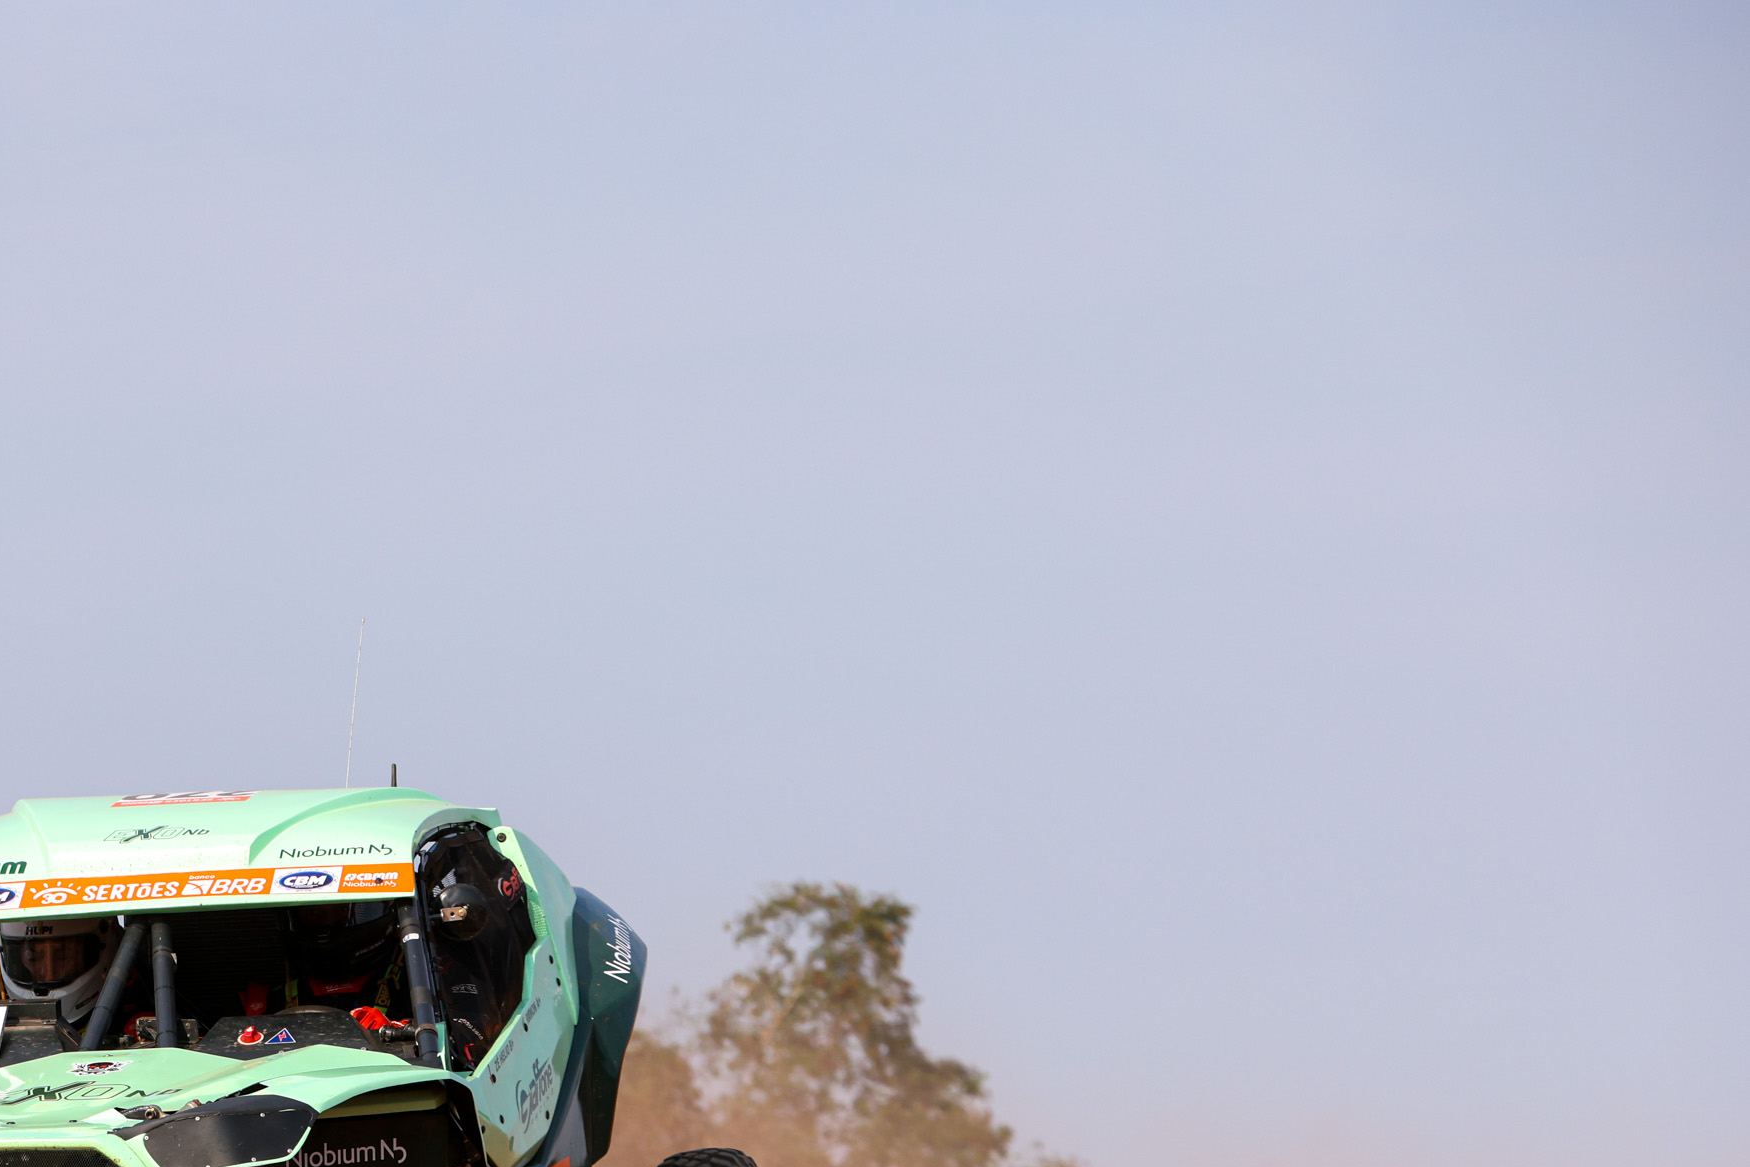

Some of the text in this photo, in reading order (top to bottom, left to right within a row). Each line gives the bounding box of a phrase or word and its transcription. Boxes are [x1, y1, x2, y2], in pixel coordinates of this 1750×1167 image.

[279, 845, 364, 859] Niobium
[209, 877, 267, 895] BRB
[283, 874, 328, 886] CBM
[41, 892, 68, 905] 30
[603, 925, 632, 984] Niobium
